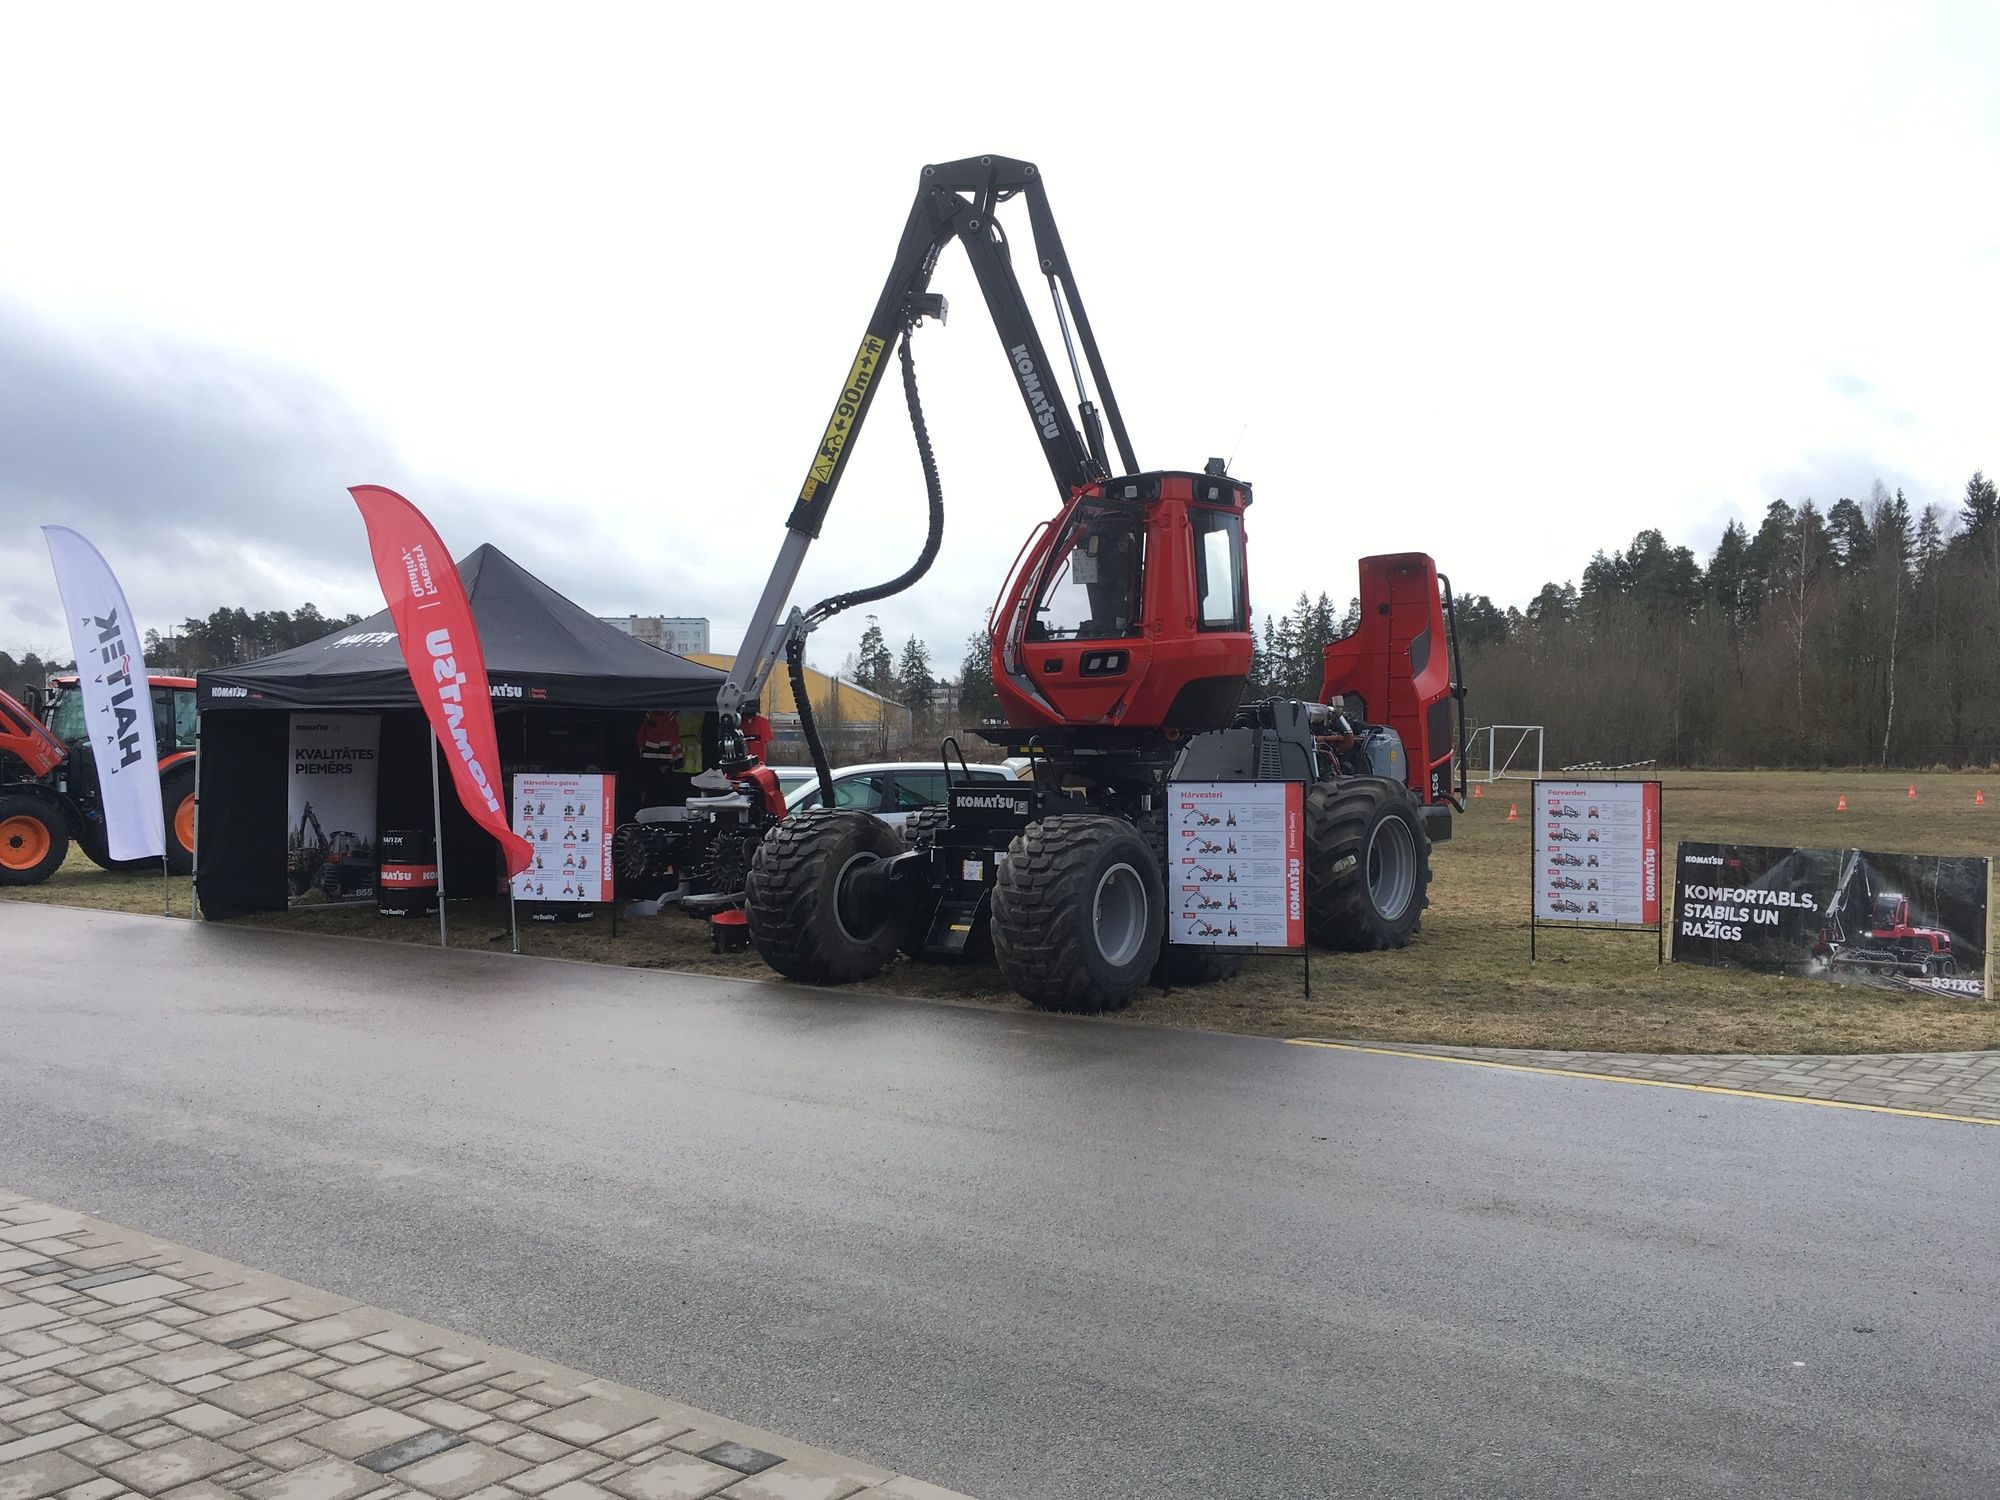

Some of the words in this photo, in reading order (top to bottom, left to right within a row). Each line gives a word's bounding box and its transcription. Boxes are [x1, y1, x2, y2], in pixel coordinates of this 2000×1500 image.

[837, 370, 870, 419] 90m
[1011, 344, 1060, 439] KOMATSU
[211, 686, 248, 698] KOMATSU
[489, 683, 522, 698] ATSU
[956, 794, 1014, 809] KOMATSU
[603, 833, 612, 881] KOMATSU
[1685, 856, 1724, 865] KOMATSU
[1644, 848, 1656, 902] KOMATSU
[1288, 858, 1300, 920] KOMATSU
[1684, 884, 1819, 912] KOMFORTABLS,
[1683, 903, 1750, 923] STABILS
[1753, 909, 1779, 925] UN
[1682, 920, 1742, 941] RAŽĪGS
